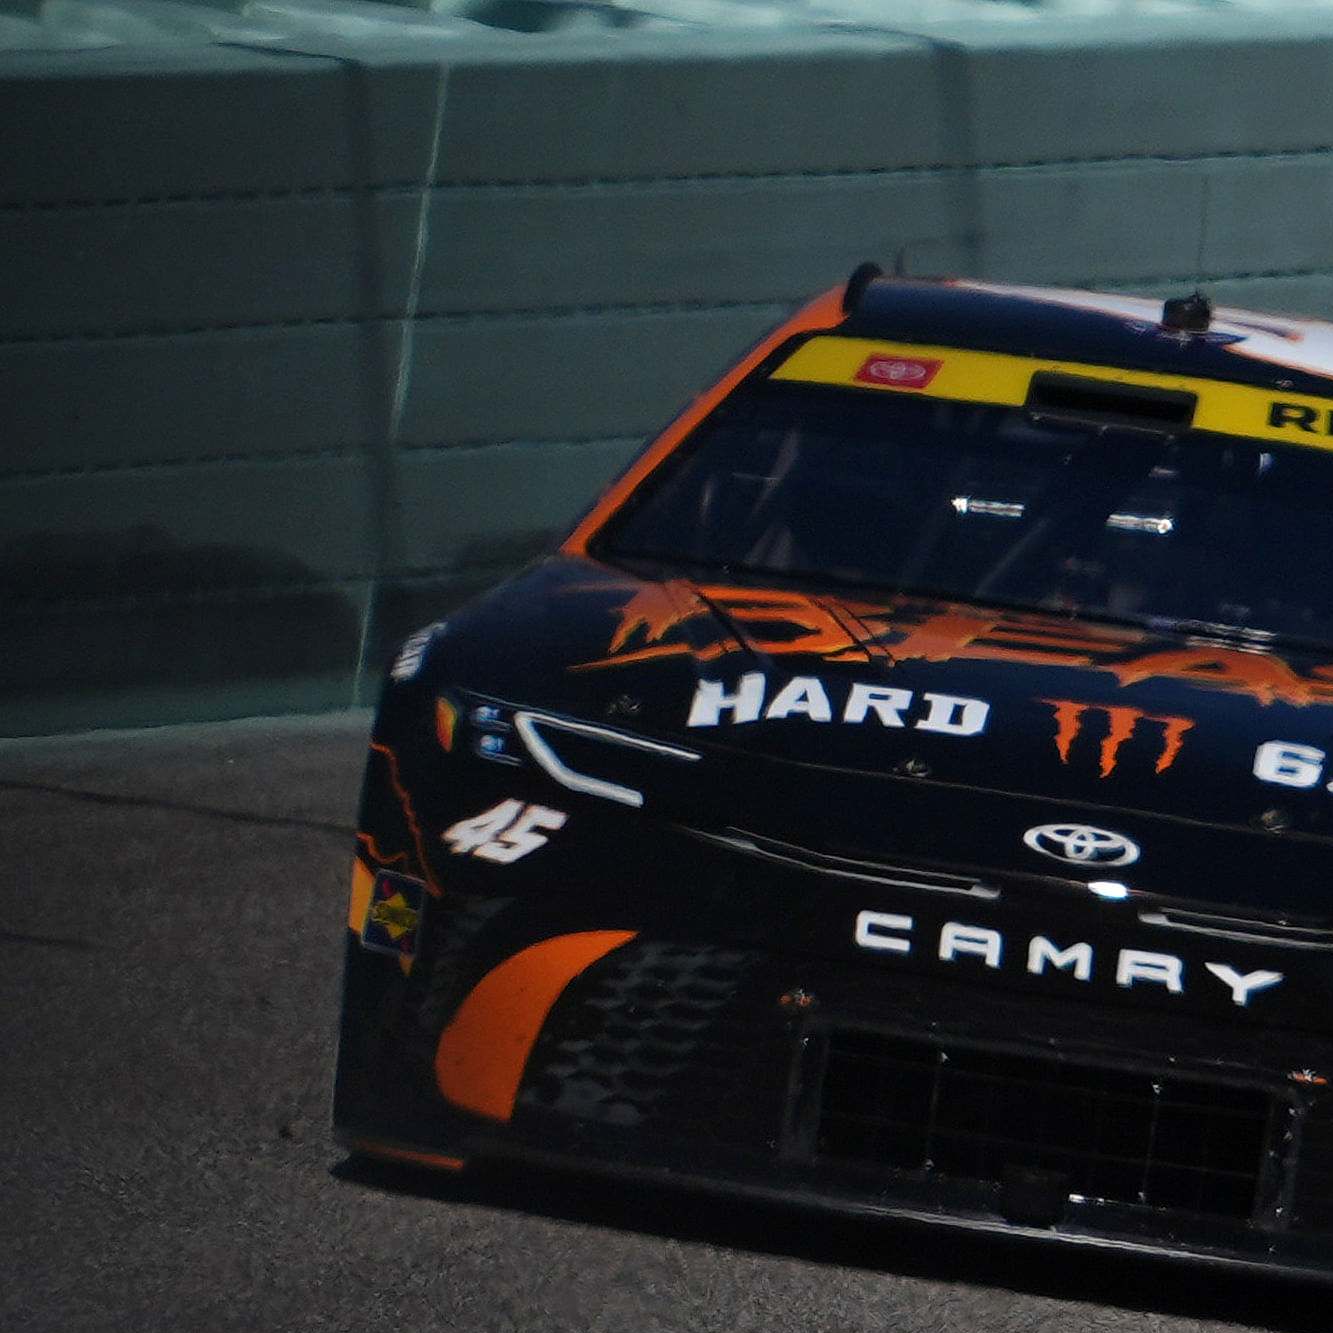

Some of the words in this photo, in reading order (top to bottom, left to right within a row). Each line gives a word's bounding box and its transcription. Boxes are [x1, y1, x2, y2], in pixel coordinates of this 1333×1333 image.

[686, 672, 990, 736] HARD
[441, 798, 569, 863] 45
[855, 910, 1283, 1006] CAMRY
